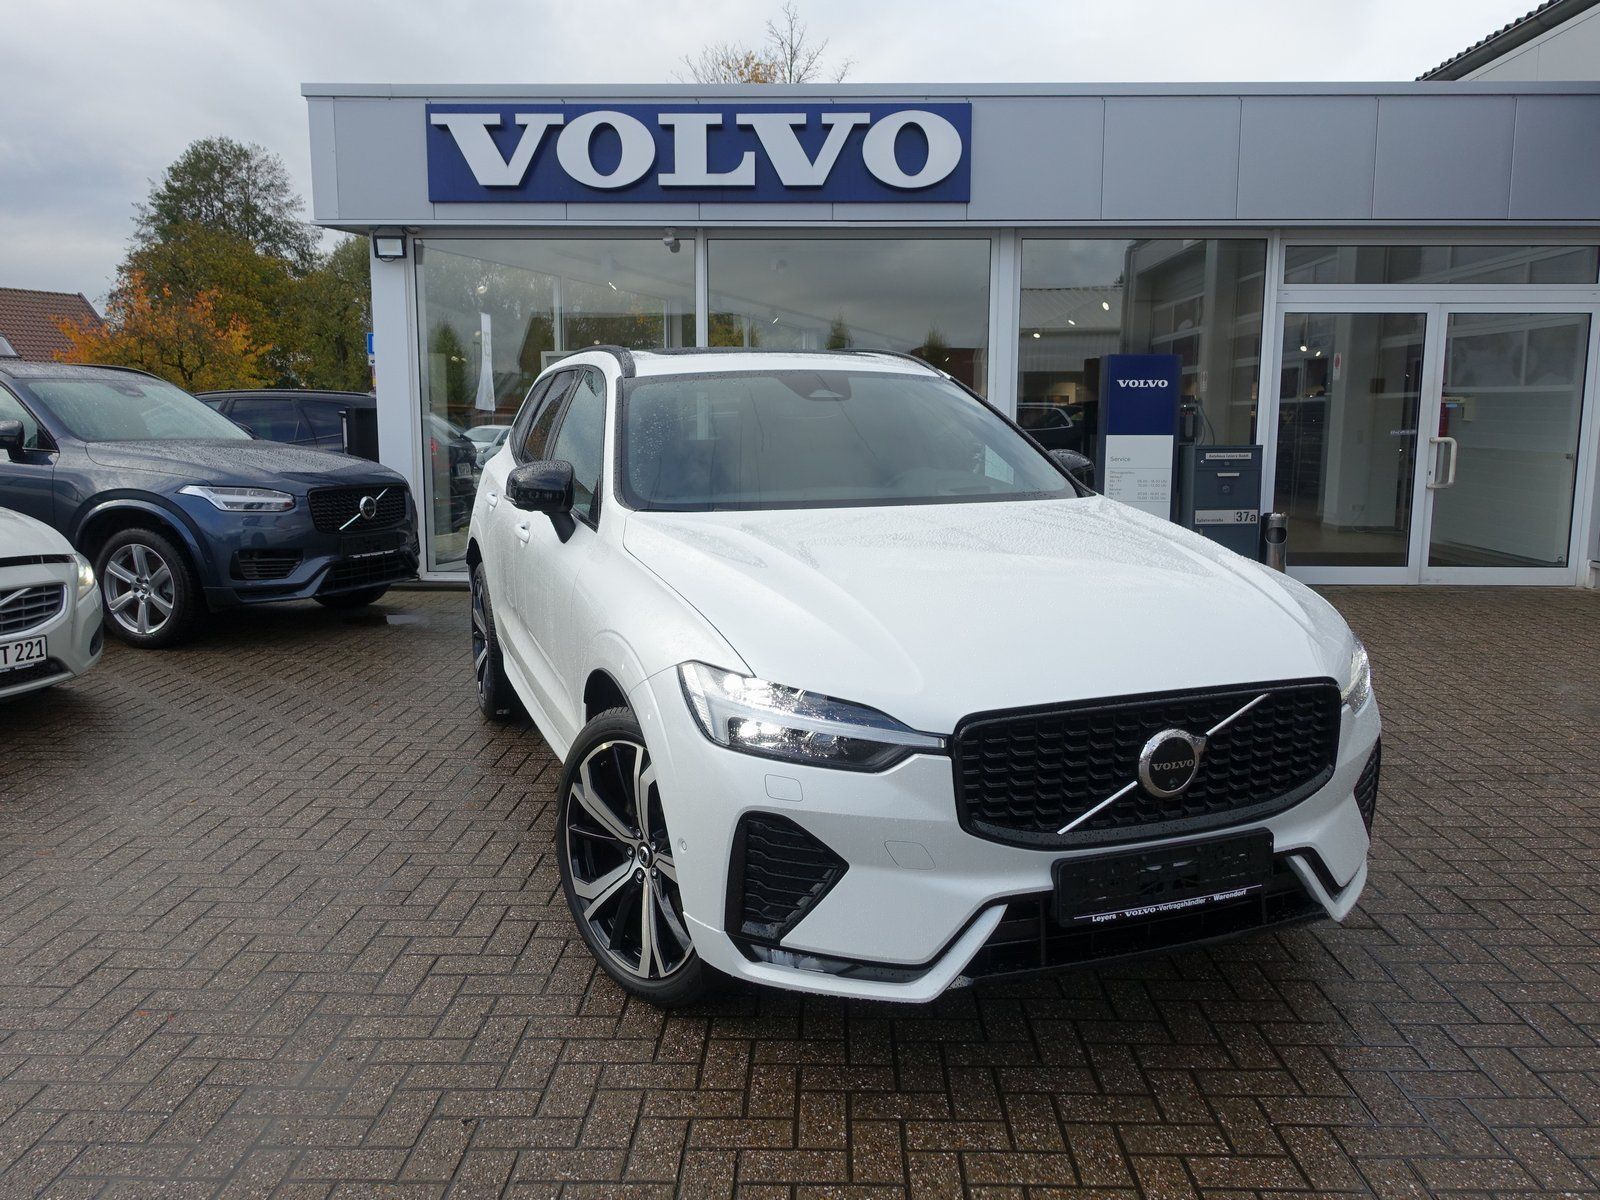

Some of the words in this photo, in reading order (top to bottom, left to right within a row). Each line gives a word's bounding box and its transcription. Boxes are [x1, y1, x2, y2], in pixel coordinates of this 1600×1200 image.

[430, 110, 962, 189] VOLVO
[1117, 379, 1168, 388] VOLVO
[1236, 511, 1257, 522] 37a
[15, 640, 44, 662] 221
[1152, 759, 1194, 771] VOLVO
[1092, 913, 1117, 922] Leyers
[1213, 889, 1247, 901] Warendorf
